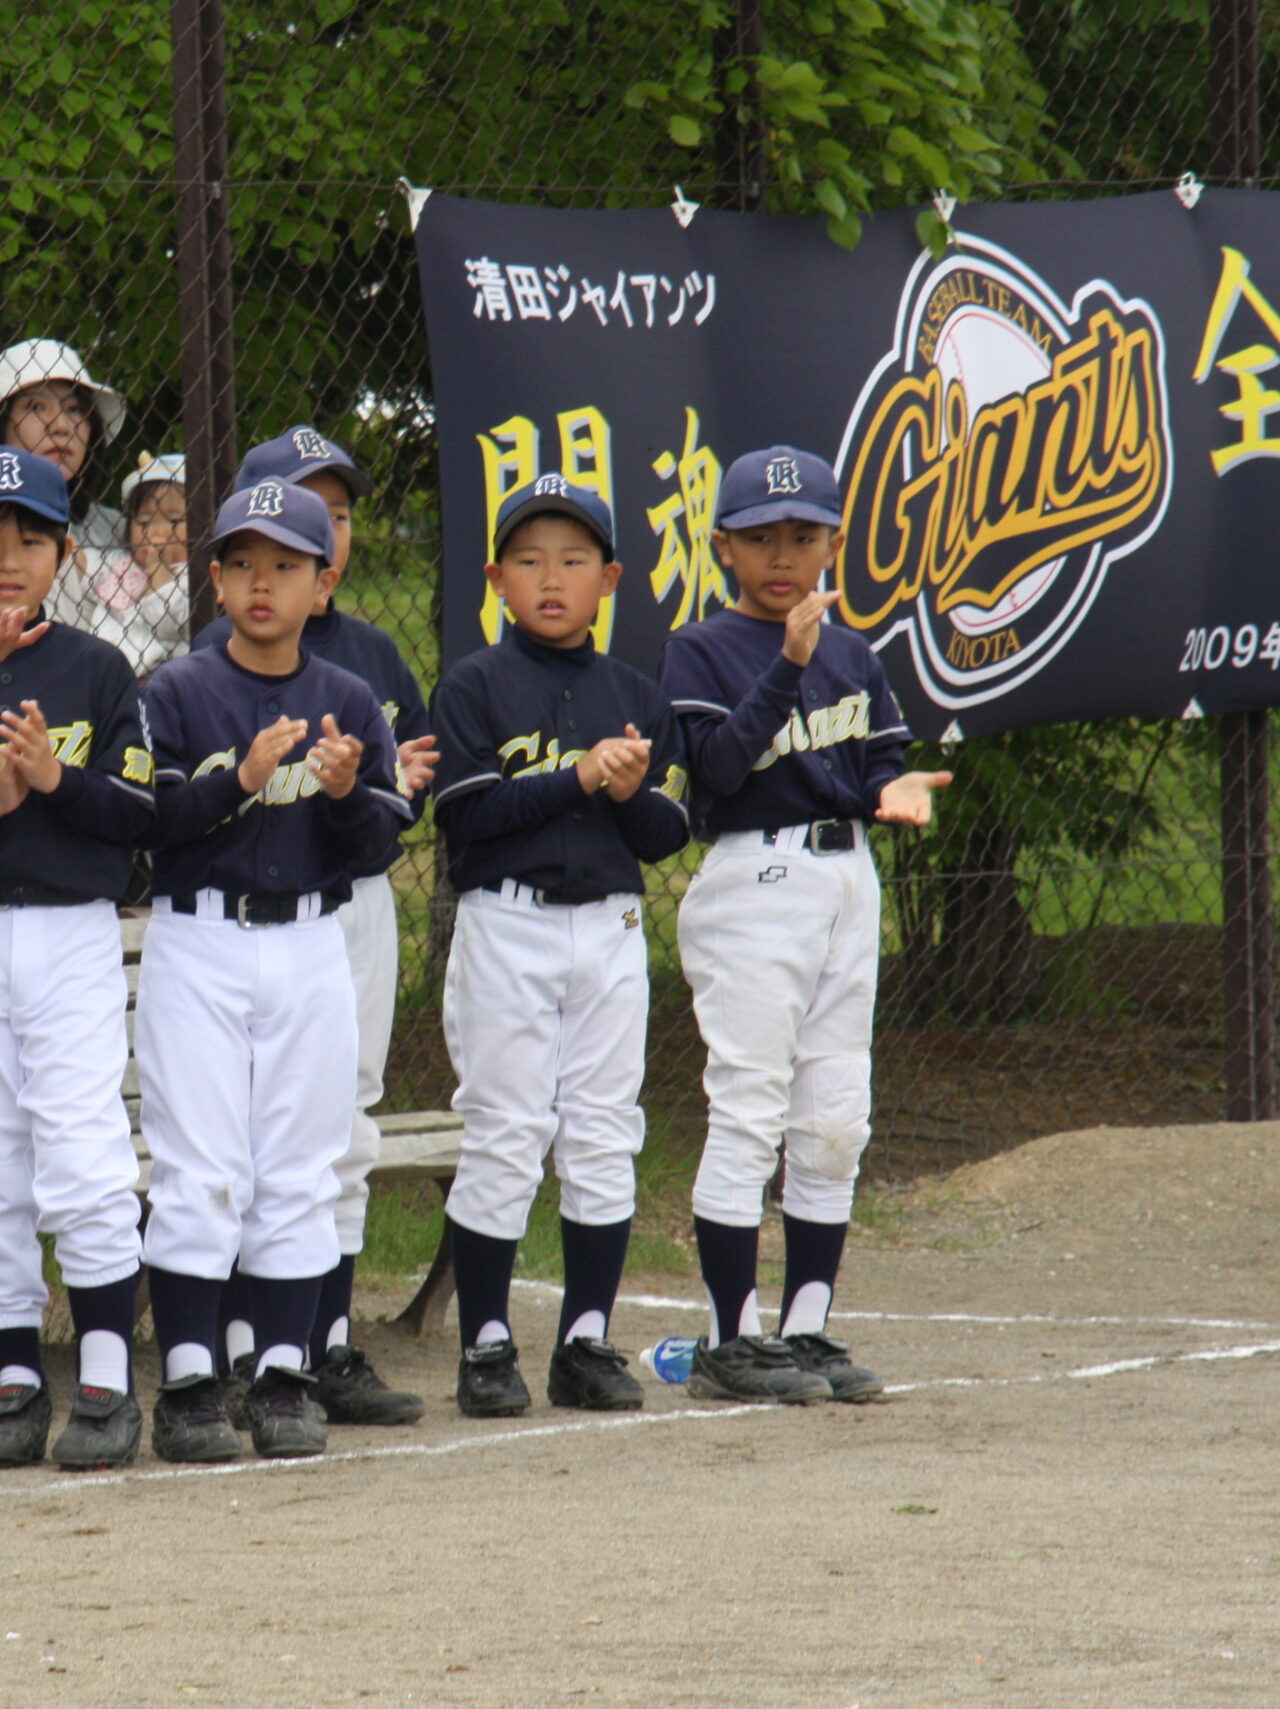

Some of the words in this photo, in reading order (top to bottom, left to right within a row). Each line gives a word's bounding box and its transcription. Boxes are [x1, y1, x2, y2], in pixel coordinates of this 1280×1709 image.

[464, 255, 716, 328] 清田ジャイアンツ
[918, 272, 983, 366] BASEBALL
[981, 278, 1053, 356] TEAM
[1192, 246, 1280, 477] 全
[835, 309, 1161, 630] Giants
[945, 628, 1022, 669] KIYOTA
